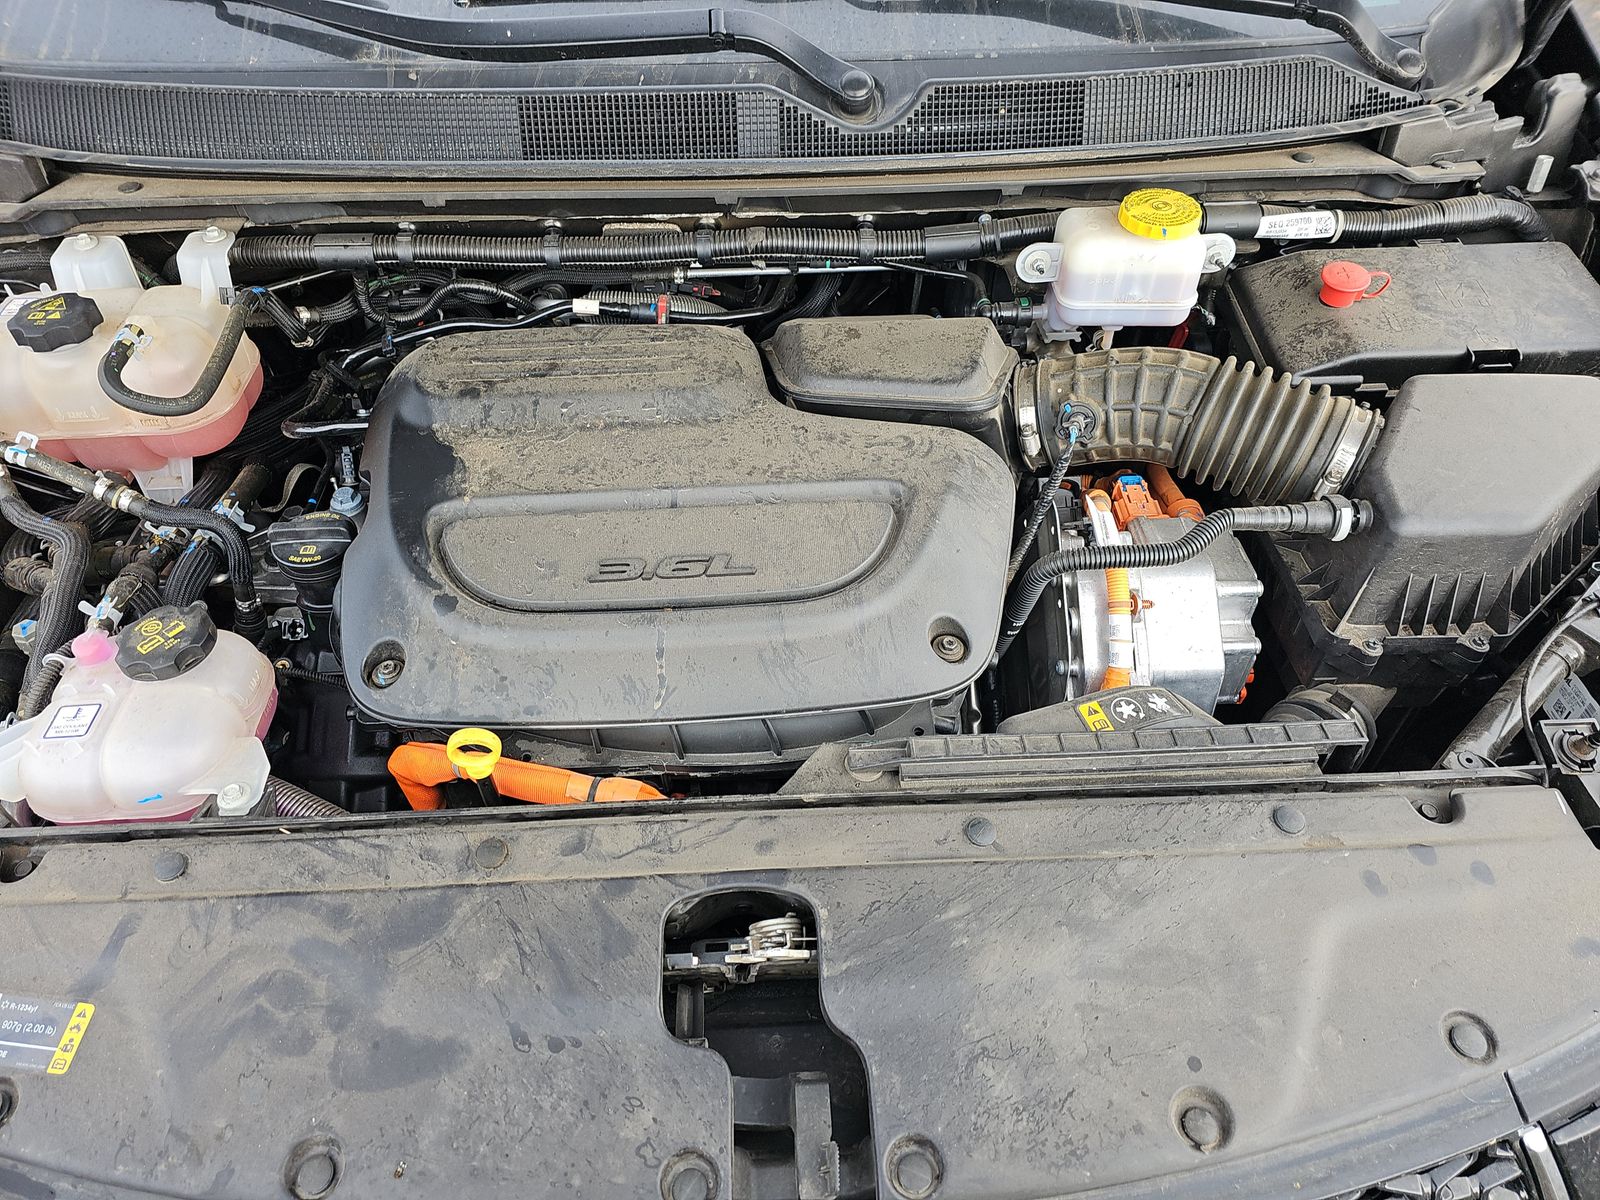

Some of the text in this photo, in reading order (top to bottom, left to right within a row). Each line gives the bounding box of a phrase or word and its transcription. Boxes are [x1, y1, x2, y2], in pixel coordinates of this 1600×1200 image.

[1268, 221, 1284, 229] SEQ
[288, 555, 301, 563] SAE
[586, 553, 757, 583] 3.6L
[10, 1004, 38, 1014] R-1234yf
[1, 1019, 57, 1036] 907g (2.00 lb)
